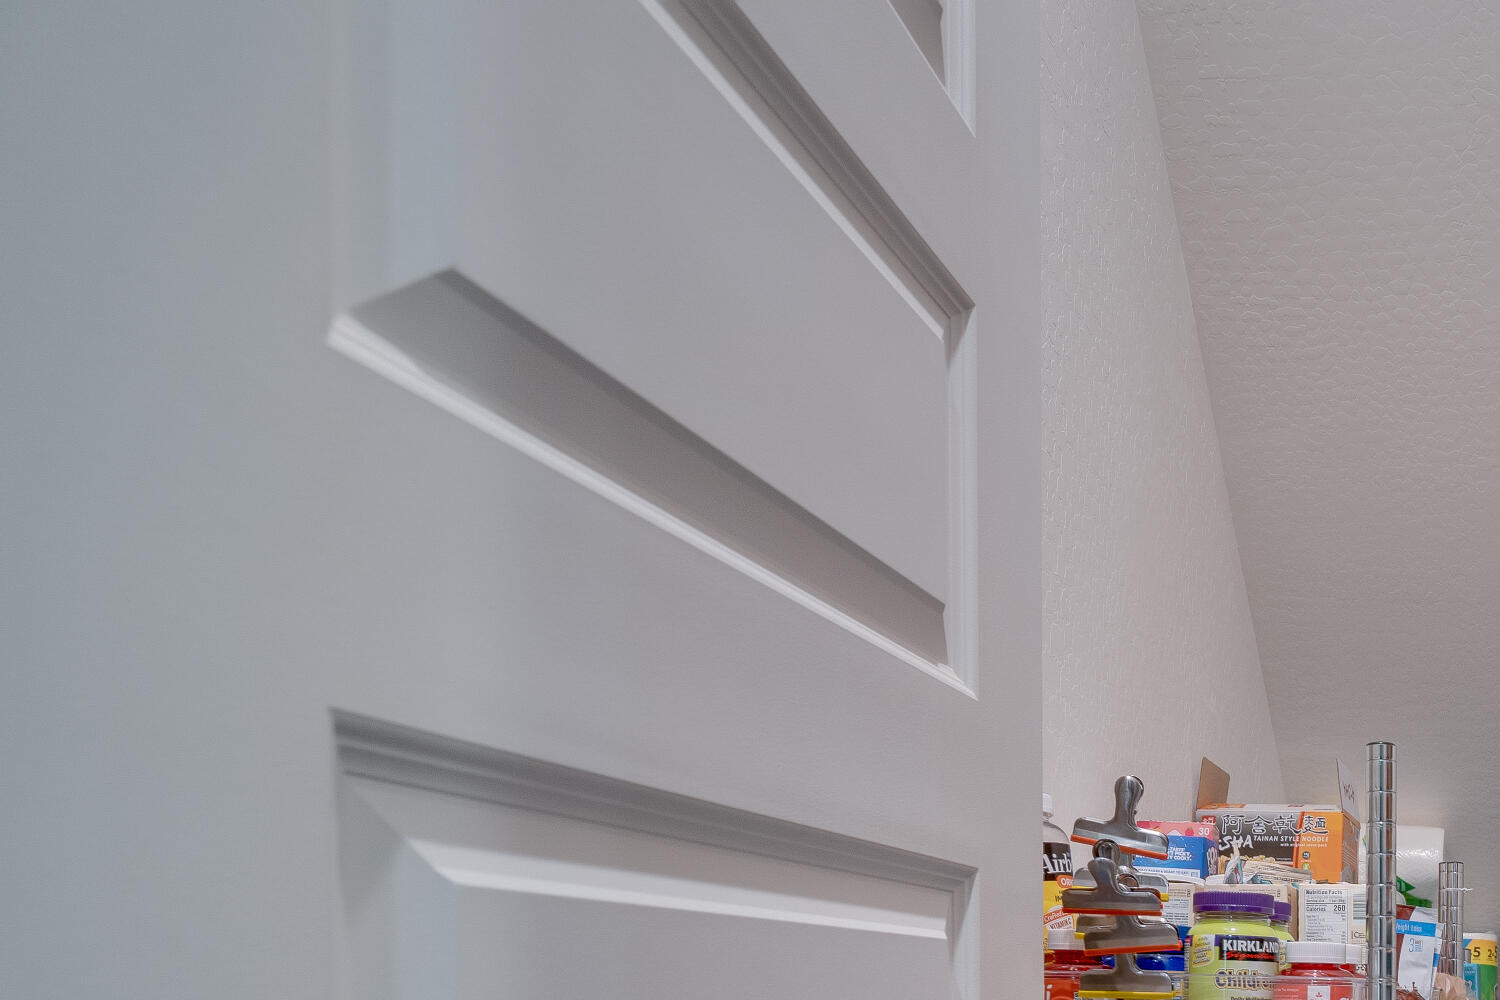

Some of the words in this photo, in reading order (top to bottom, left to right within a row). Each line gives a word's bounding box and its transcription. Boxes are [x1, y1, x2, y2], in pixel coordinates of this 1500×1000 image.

[1221, 813, 1329, 836] 阿舍乾麵
[1198, 827, 1210, 836] 30
[1223, 939, 1280, 953] KIRKLAND
[1472, 946, 1481, 957] 5
